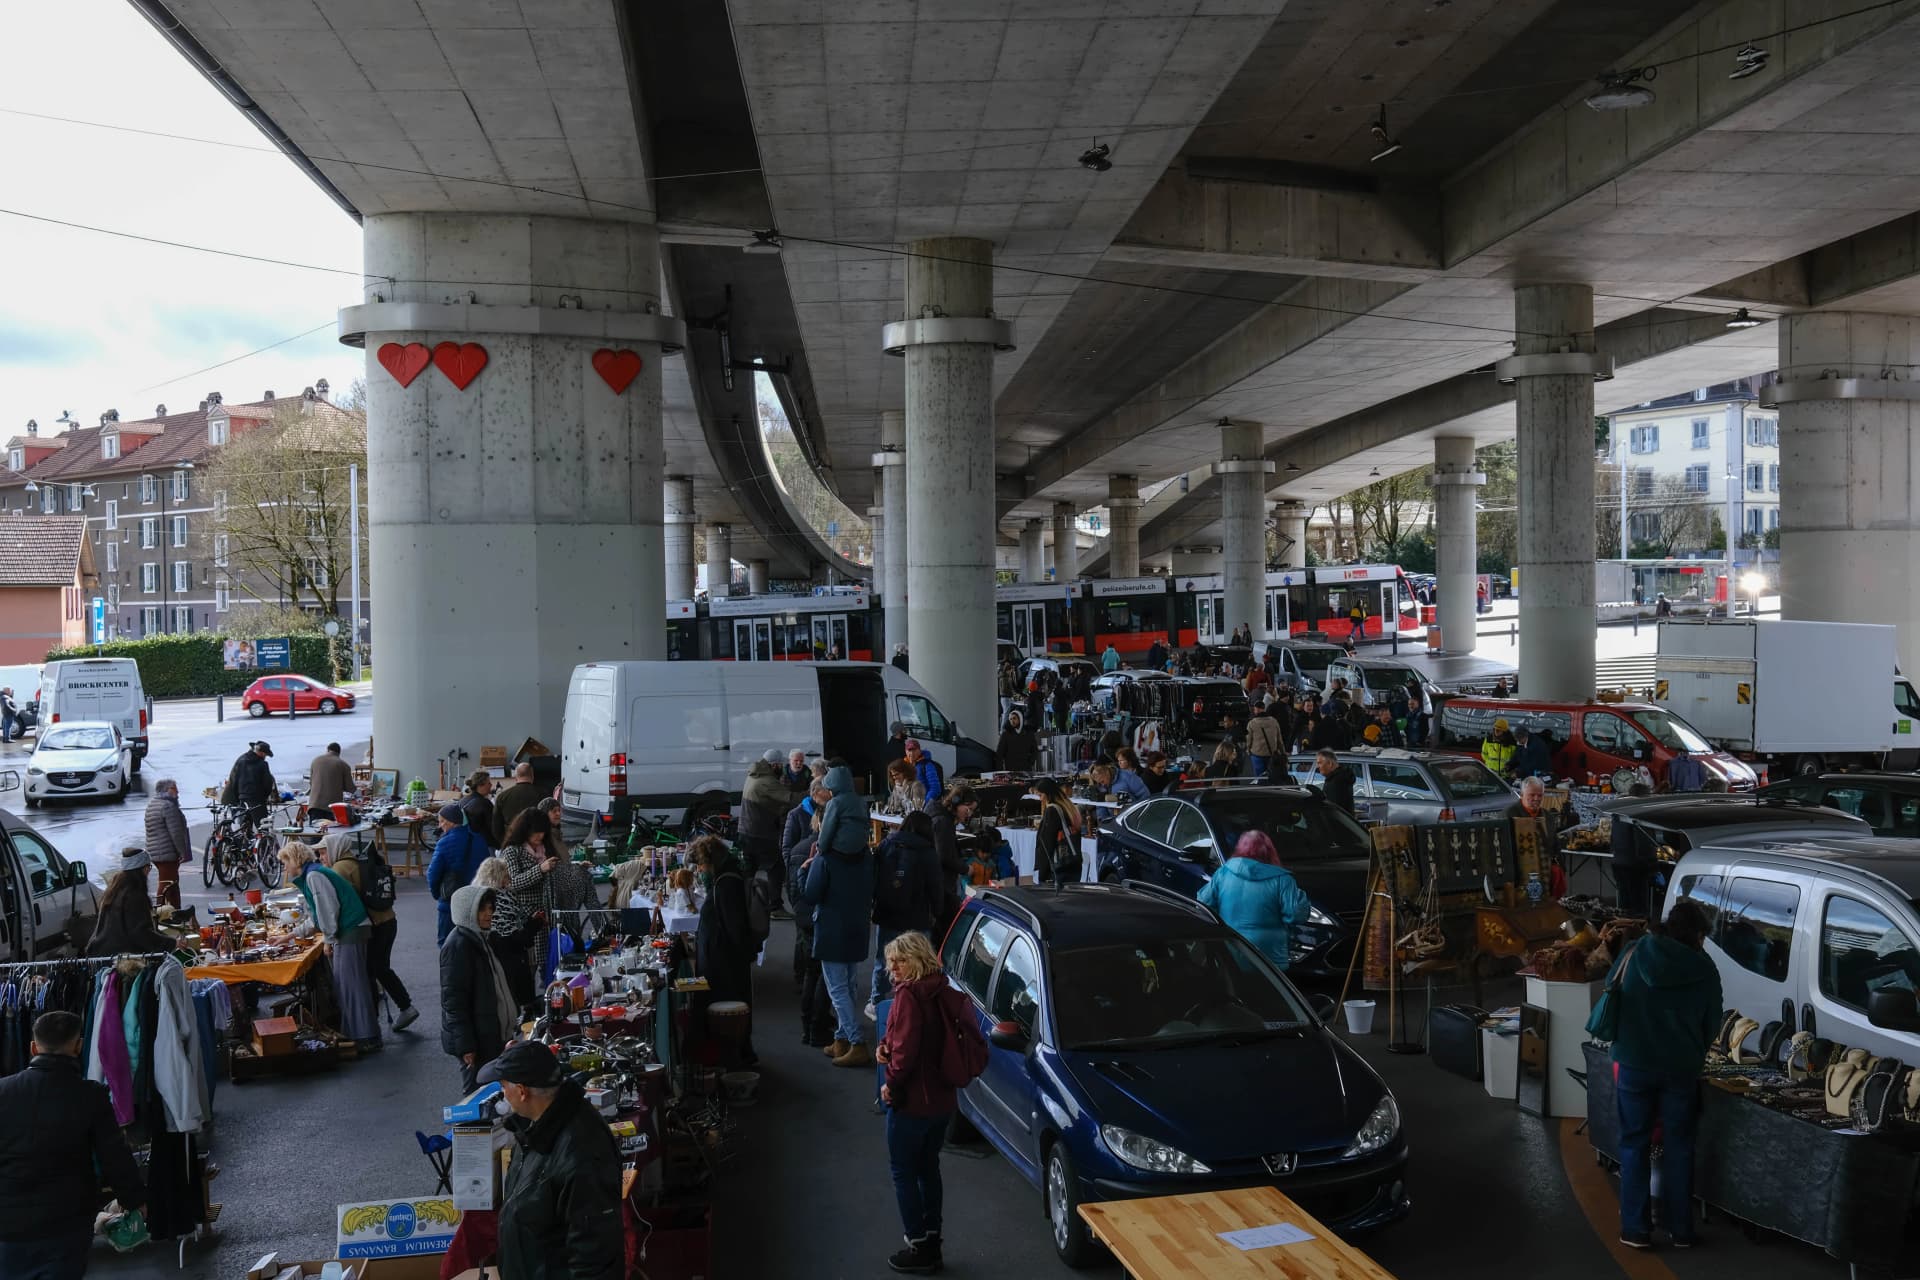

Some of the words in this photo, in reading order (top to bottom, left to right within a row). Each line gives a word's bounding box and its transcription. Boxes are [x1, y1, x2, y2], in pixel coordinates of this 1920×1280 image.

[1102, 583, 1156, 593] polizeiberufe.ch
[68, 681, 129, 689] BROCKICENTER
[389, 1213, 412, 1222] Chiquita
[348, 1244, 397, 1257] BANANAS
[405, 1240, 453, 1251] PREMIUM
